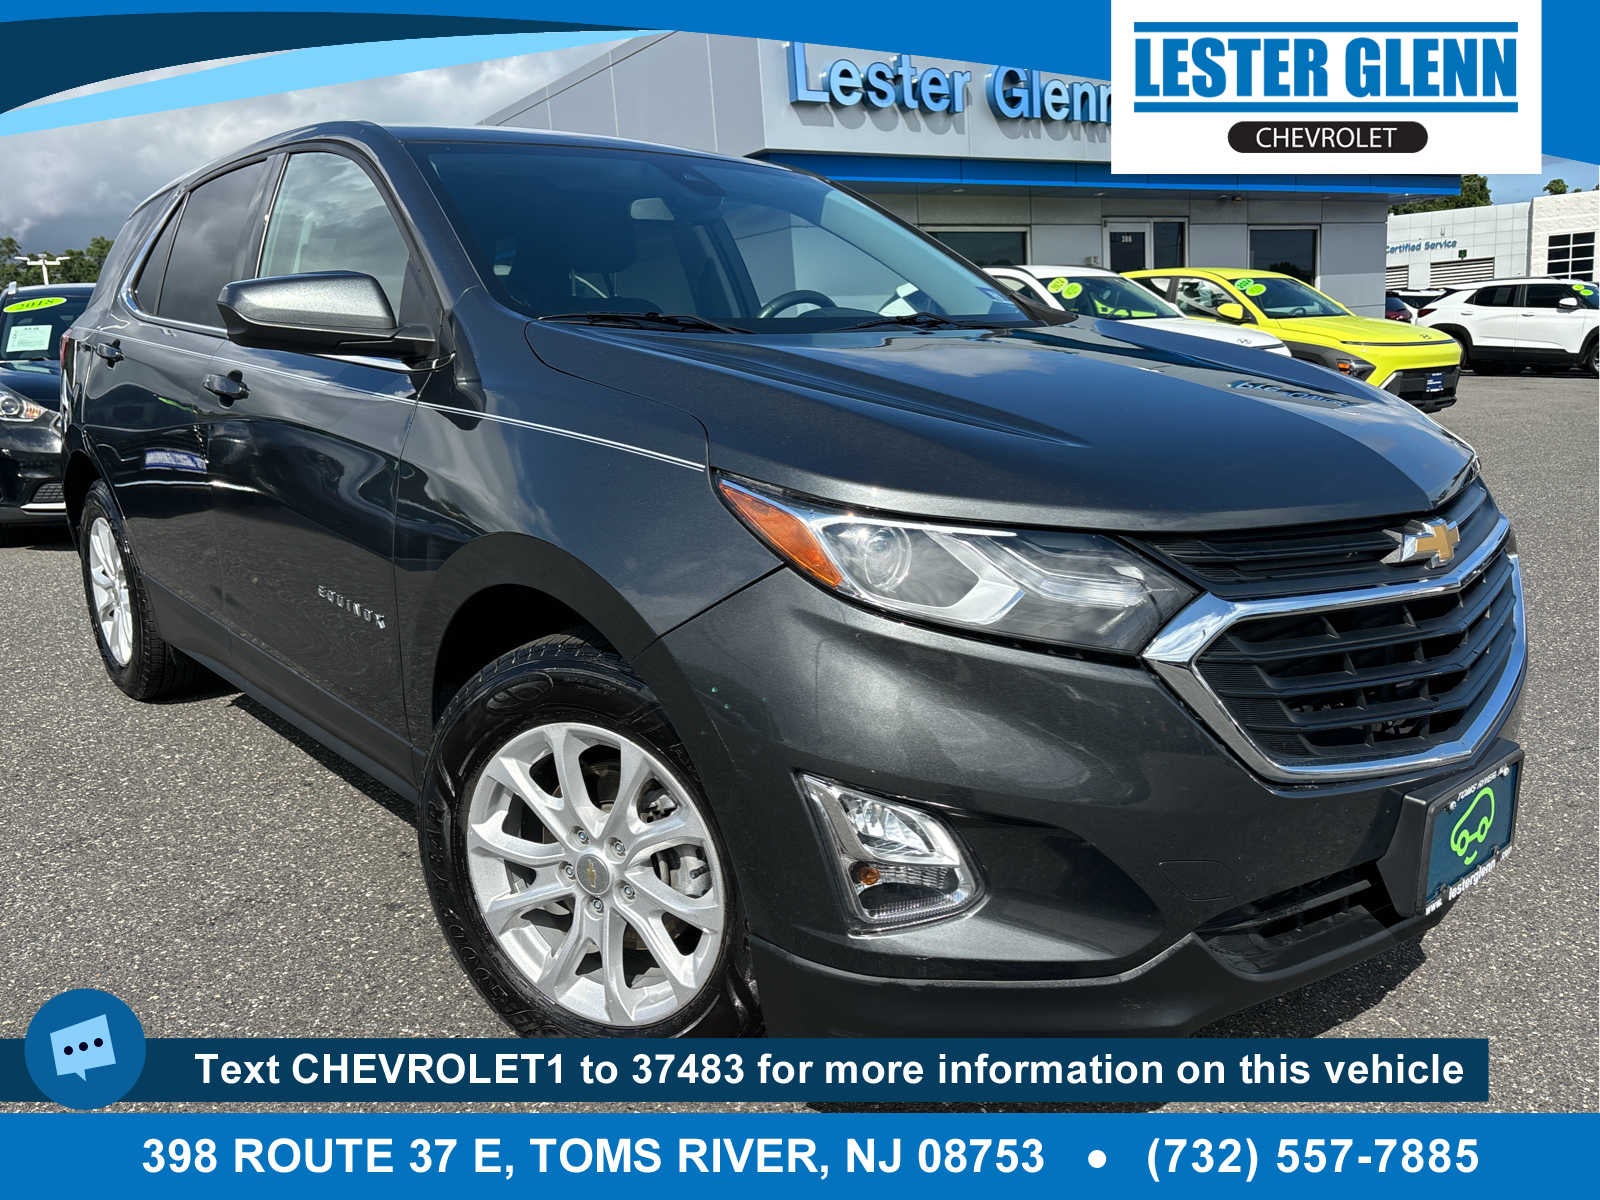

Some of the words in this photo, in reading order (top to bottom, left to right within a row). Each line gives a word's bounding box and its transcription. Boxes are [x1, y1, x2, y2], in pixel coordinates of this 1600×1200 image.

[787, 41, 972, 114] Lester
[1425, 240, 1457, 250] Service
[317, 585, 386, 629] EQUINOX
